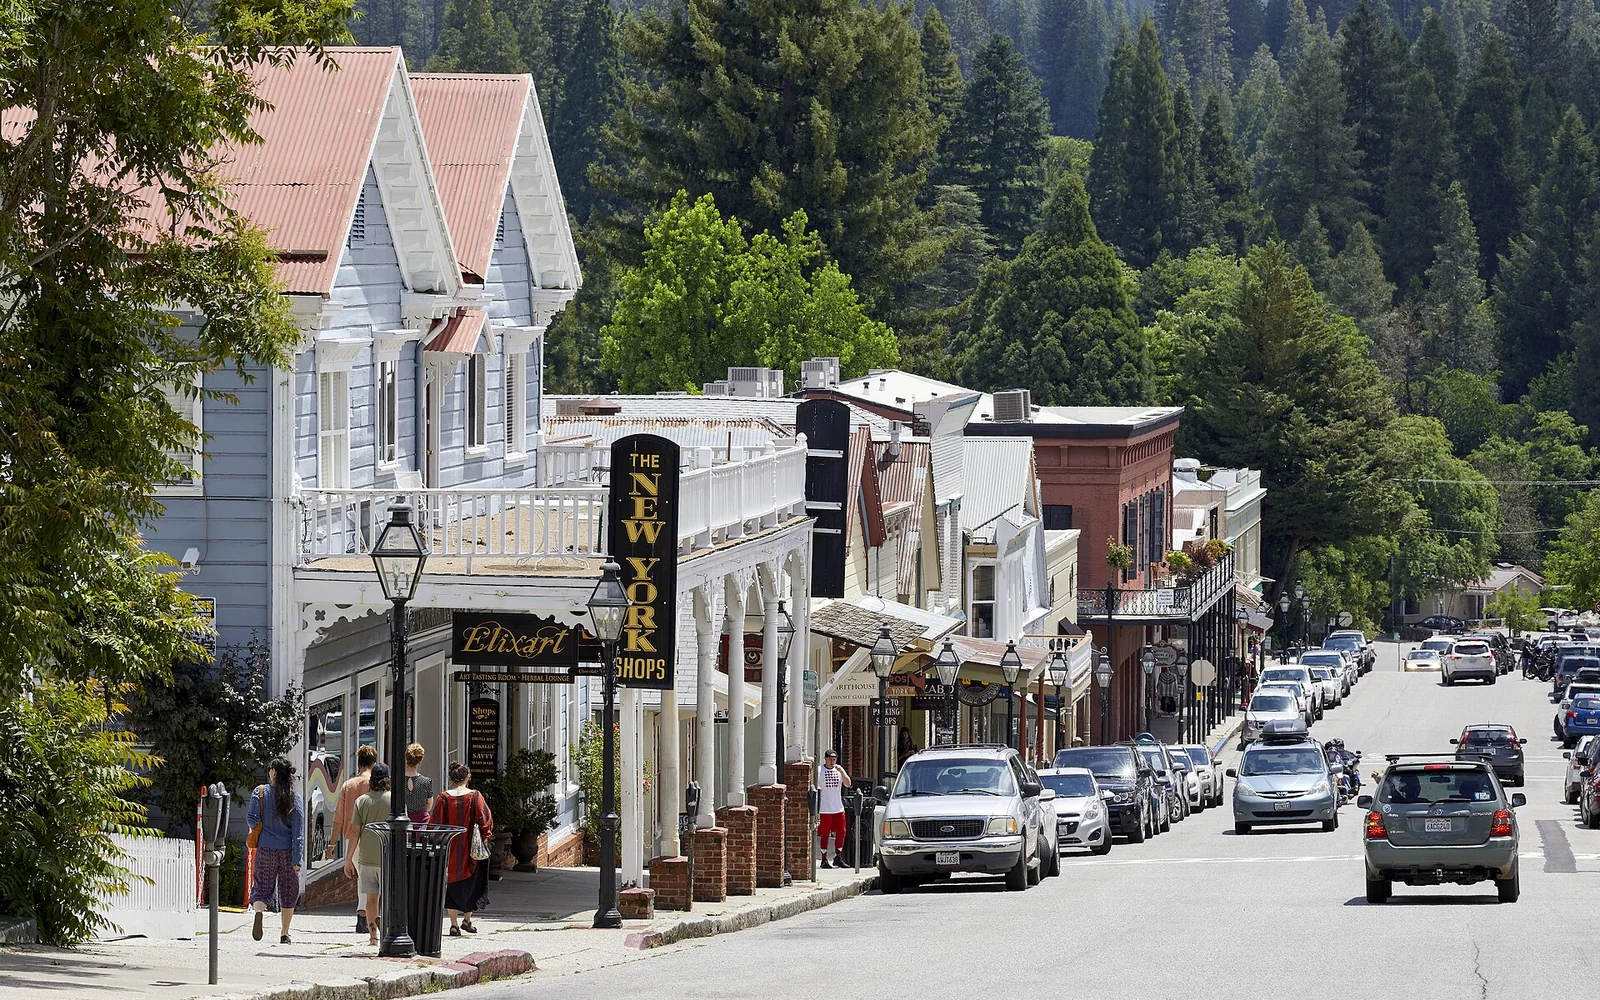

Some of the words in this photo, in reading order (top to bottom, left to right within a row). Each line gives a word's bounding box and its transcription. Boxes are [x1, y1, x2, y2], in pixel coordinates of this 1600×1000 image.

[630, 453, 660, 468] THE
[621, 472, 666, 544] NEW
[623, 557, 660, 653] YORK
[460, 620, 570, 660] Elixart
[614, 657, 666, 680] SHOPS
[472, 673, 497, 681] TASTING
[521, 674, 544, 682] HERBAL
[888, 675, 907, 683] BOS
[472, 707, 497, 716] Shops
[872, 708, 900, 716] PAKING
[875, 717, 897, 725] SOPS
